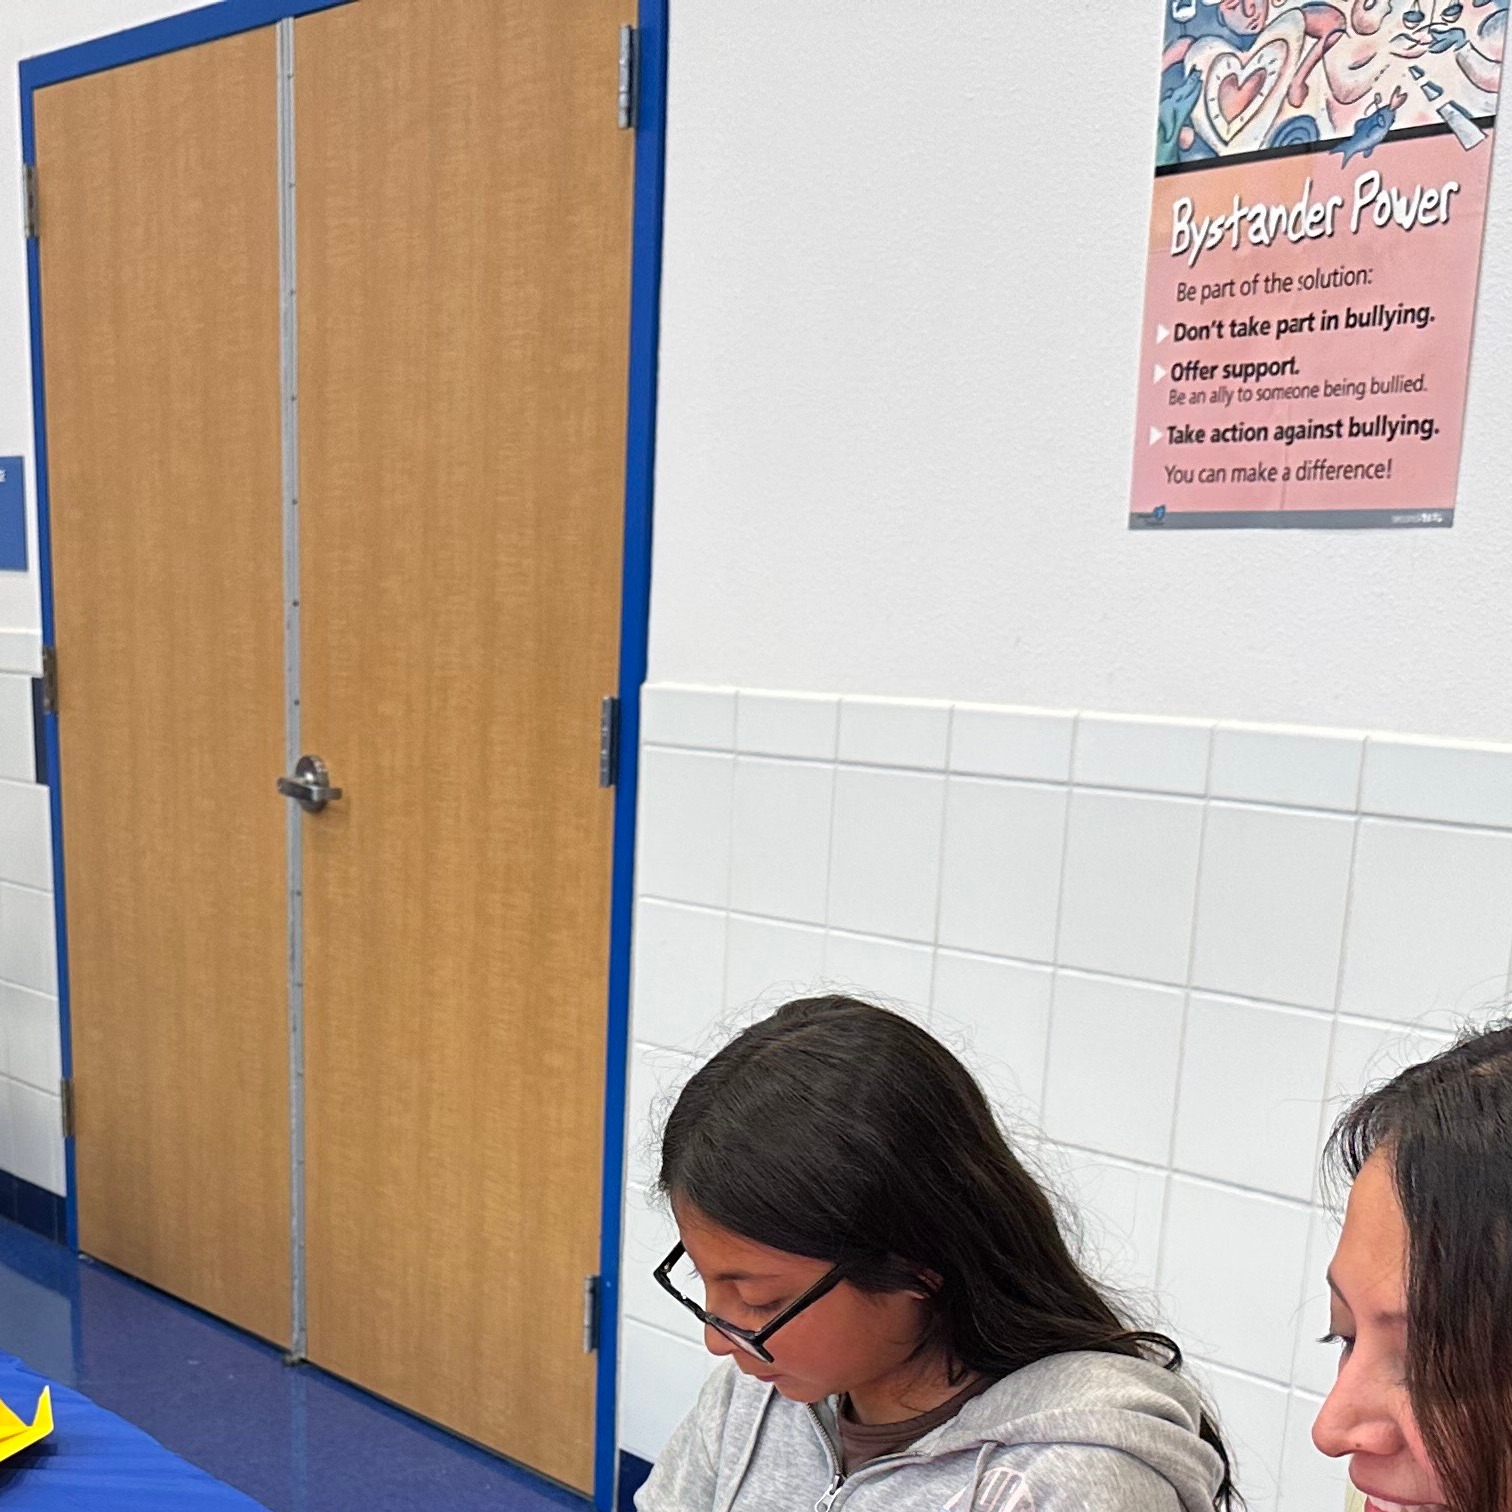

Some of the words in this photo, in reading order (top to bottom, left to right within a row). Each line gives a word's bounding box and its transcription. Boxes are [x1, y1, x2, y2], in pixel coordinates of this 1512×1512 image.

[1170, 177, 1344, 268] Bystander
[1350, 169, 1460, 234] Power
[1177, 282, 1196, 301] Be
[1200, 280, 1235, 305] part
[1240, 273, 1261, 296] of
[1264, 272, 1293, 294] the
[1298, 266, 1373, 291] solution:
[1229, 316, 1271, 338] take
[1275, 312, 1315, 340] part
[1320, 310, 1338, 331] in
[1344, 303, 1436, 332] bullying.
[1170, 360, 1218, 382] Offer
[1222, 356, 1300, 384] support.
[1168, 389, 1186, 405] Be
[1189, 390, 1206, 405] an
[1209, 385, 1233, 407] ally
[1238, 386, 1252, 402] to
[1255, 382, 1319, 401] someone
[1323, 377, 1366, 400] being
[1370, 373, 1428, 395] bullied.
[1167, 424, 1204, 445] Take
[1210, 421, 1267, 443] action
[1273, 418, 1343, 446] against
[1348, 415, 1440, 442] bullying.
[1164, 464, 1194, 485] You
[1198, 466, 1226, 483] can
[1230, 461, 1278, 483] make
[1282, 467, 1291, 481] a
[1295, 459, 1393, 481] difference!
